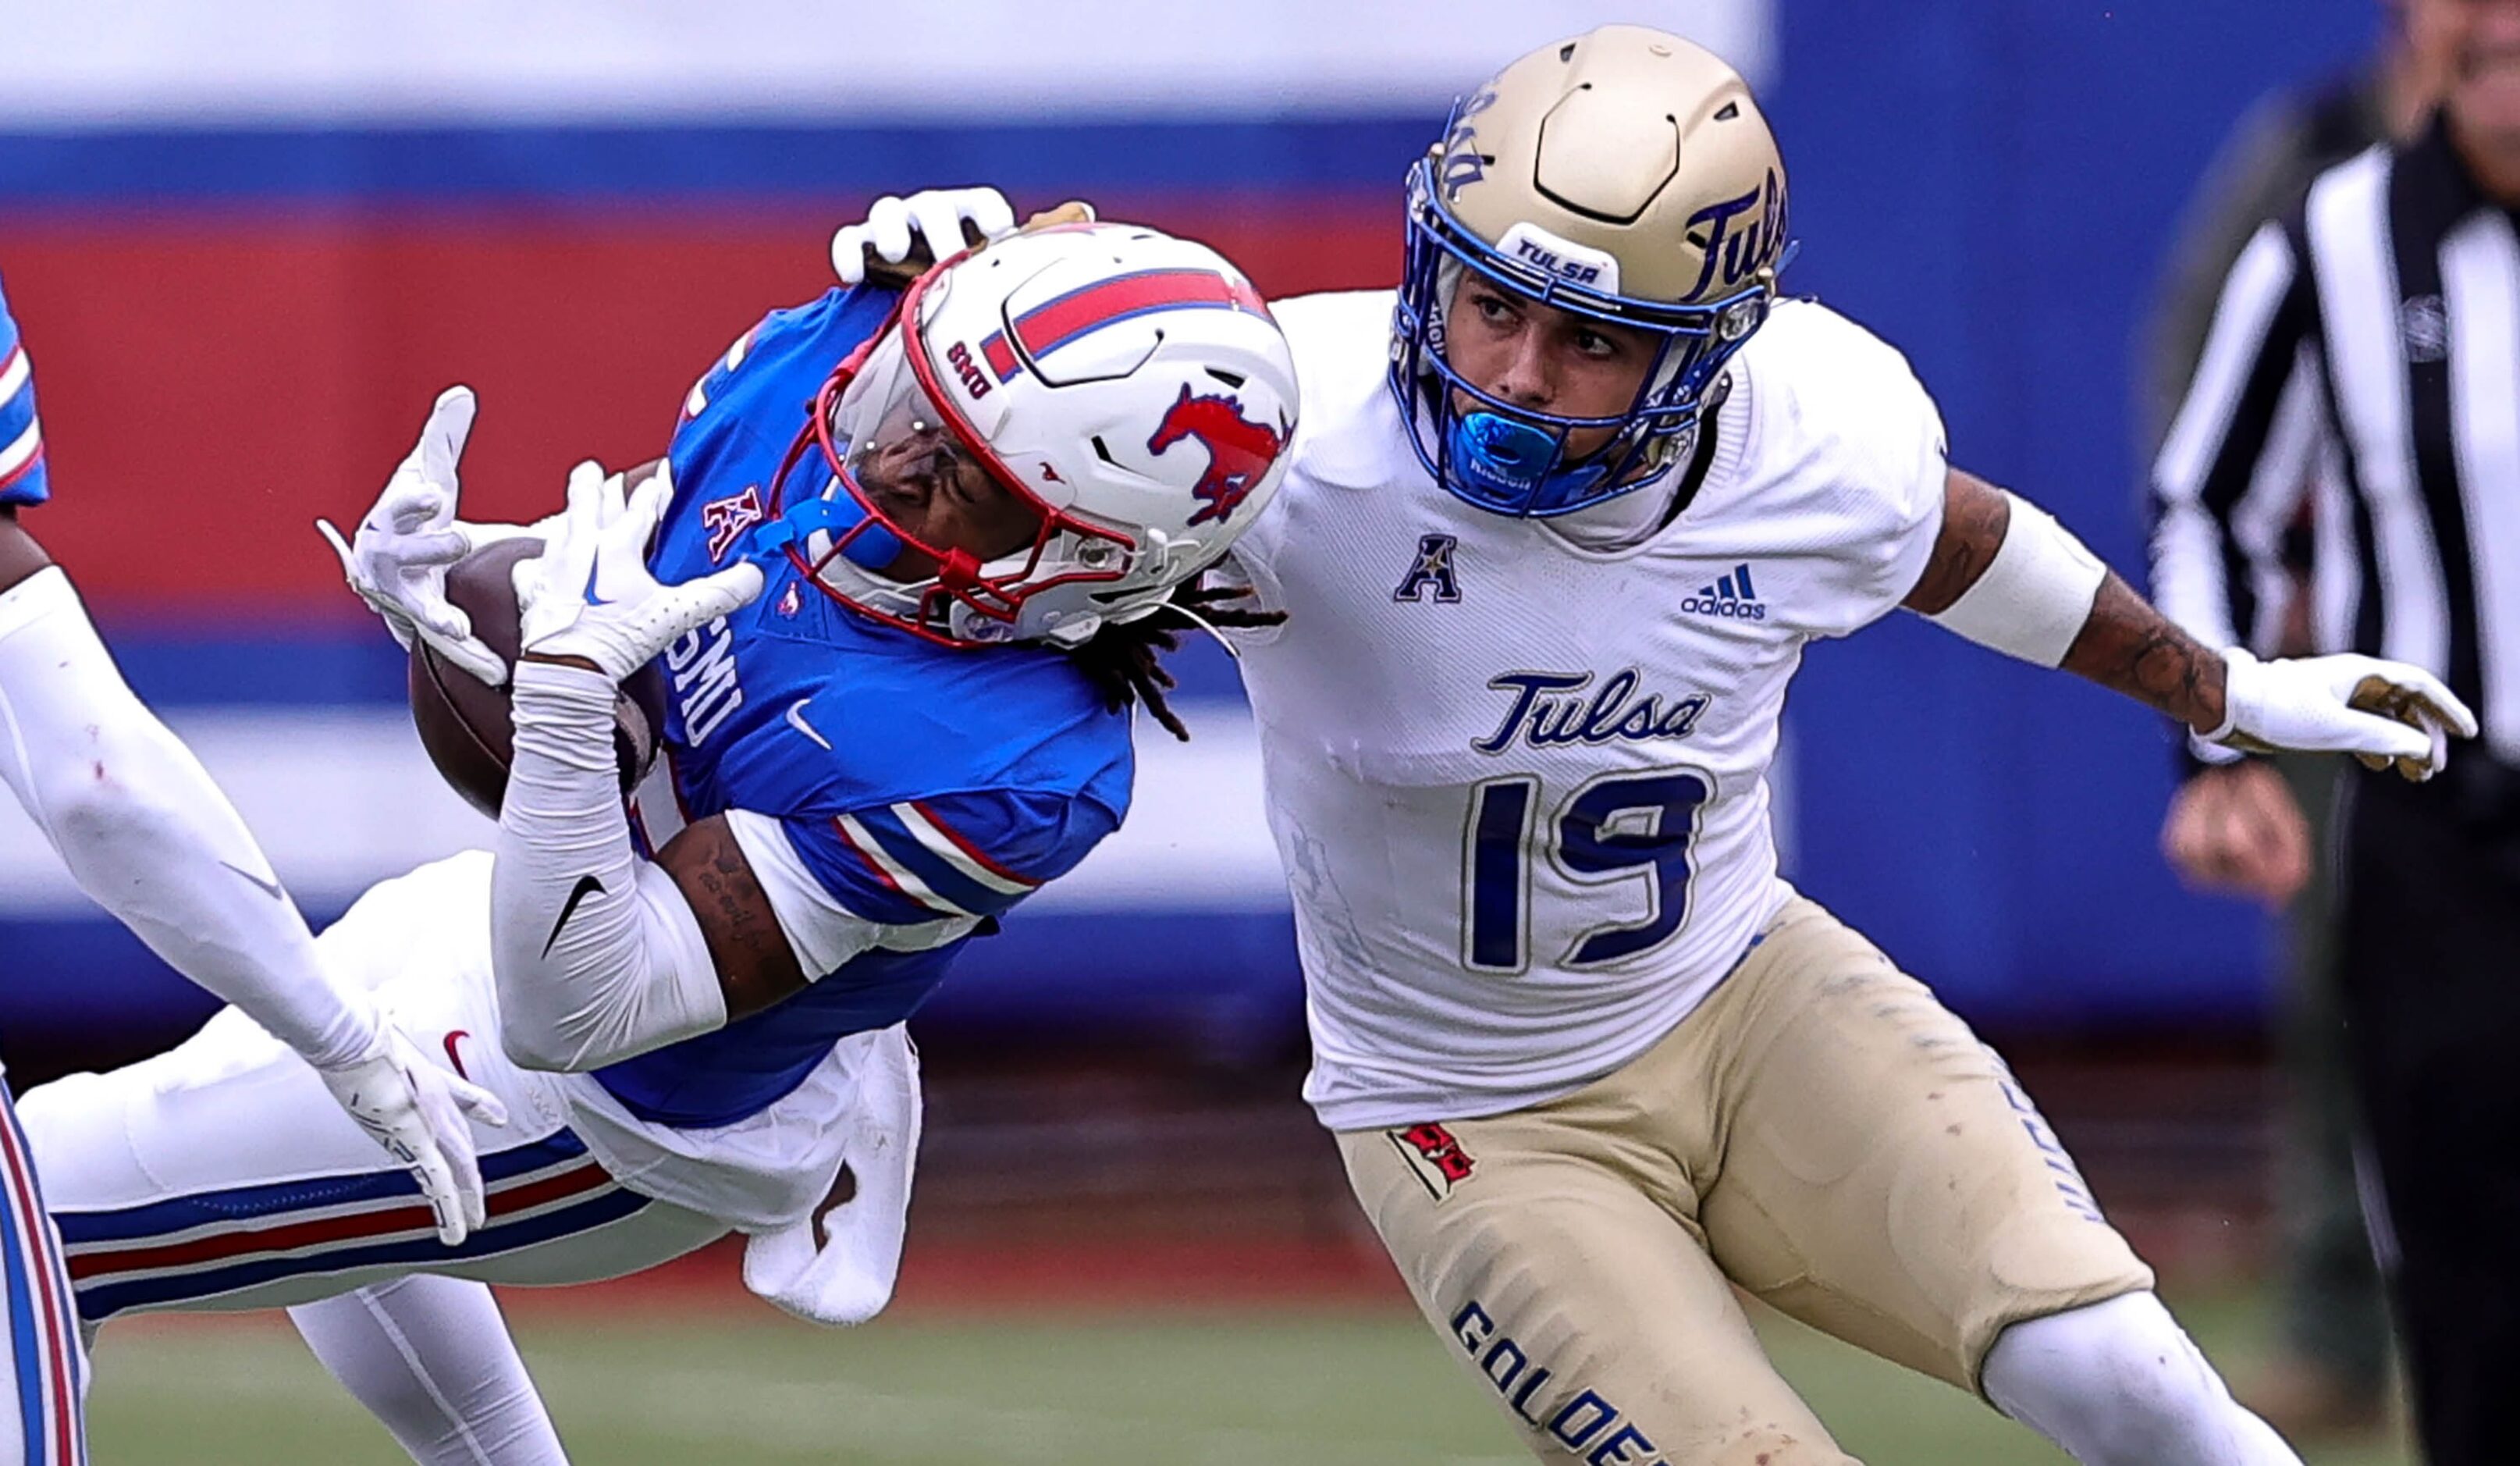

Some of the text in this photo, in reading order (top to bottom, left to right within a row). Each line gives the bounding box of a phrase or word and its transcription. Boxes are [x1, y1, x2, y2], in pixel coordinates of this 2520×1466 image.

[1517, 237, 1601, 284] TULSA
[947, 340, 993, 400] SMU
[1393, 533, 1463, 604] A
[1680, 594, 1766, 621] adidas
[1470, 667, 1712, 756] Tulsa
[1461, 763, 1718, 977] 19
[1449, 1299, 1670, 1466] GOLDE
